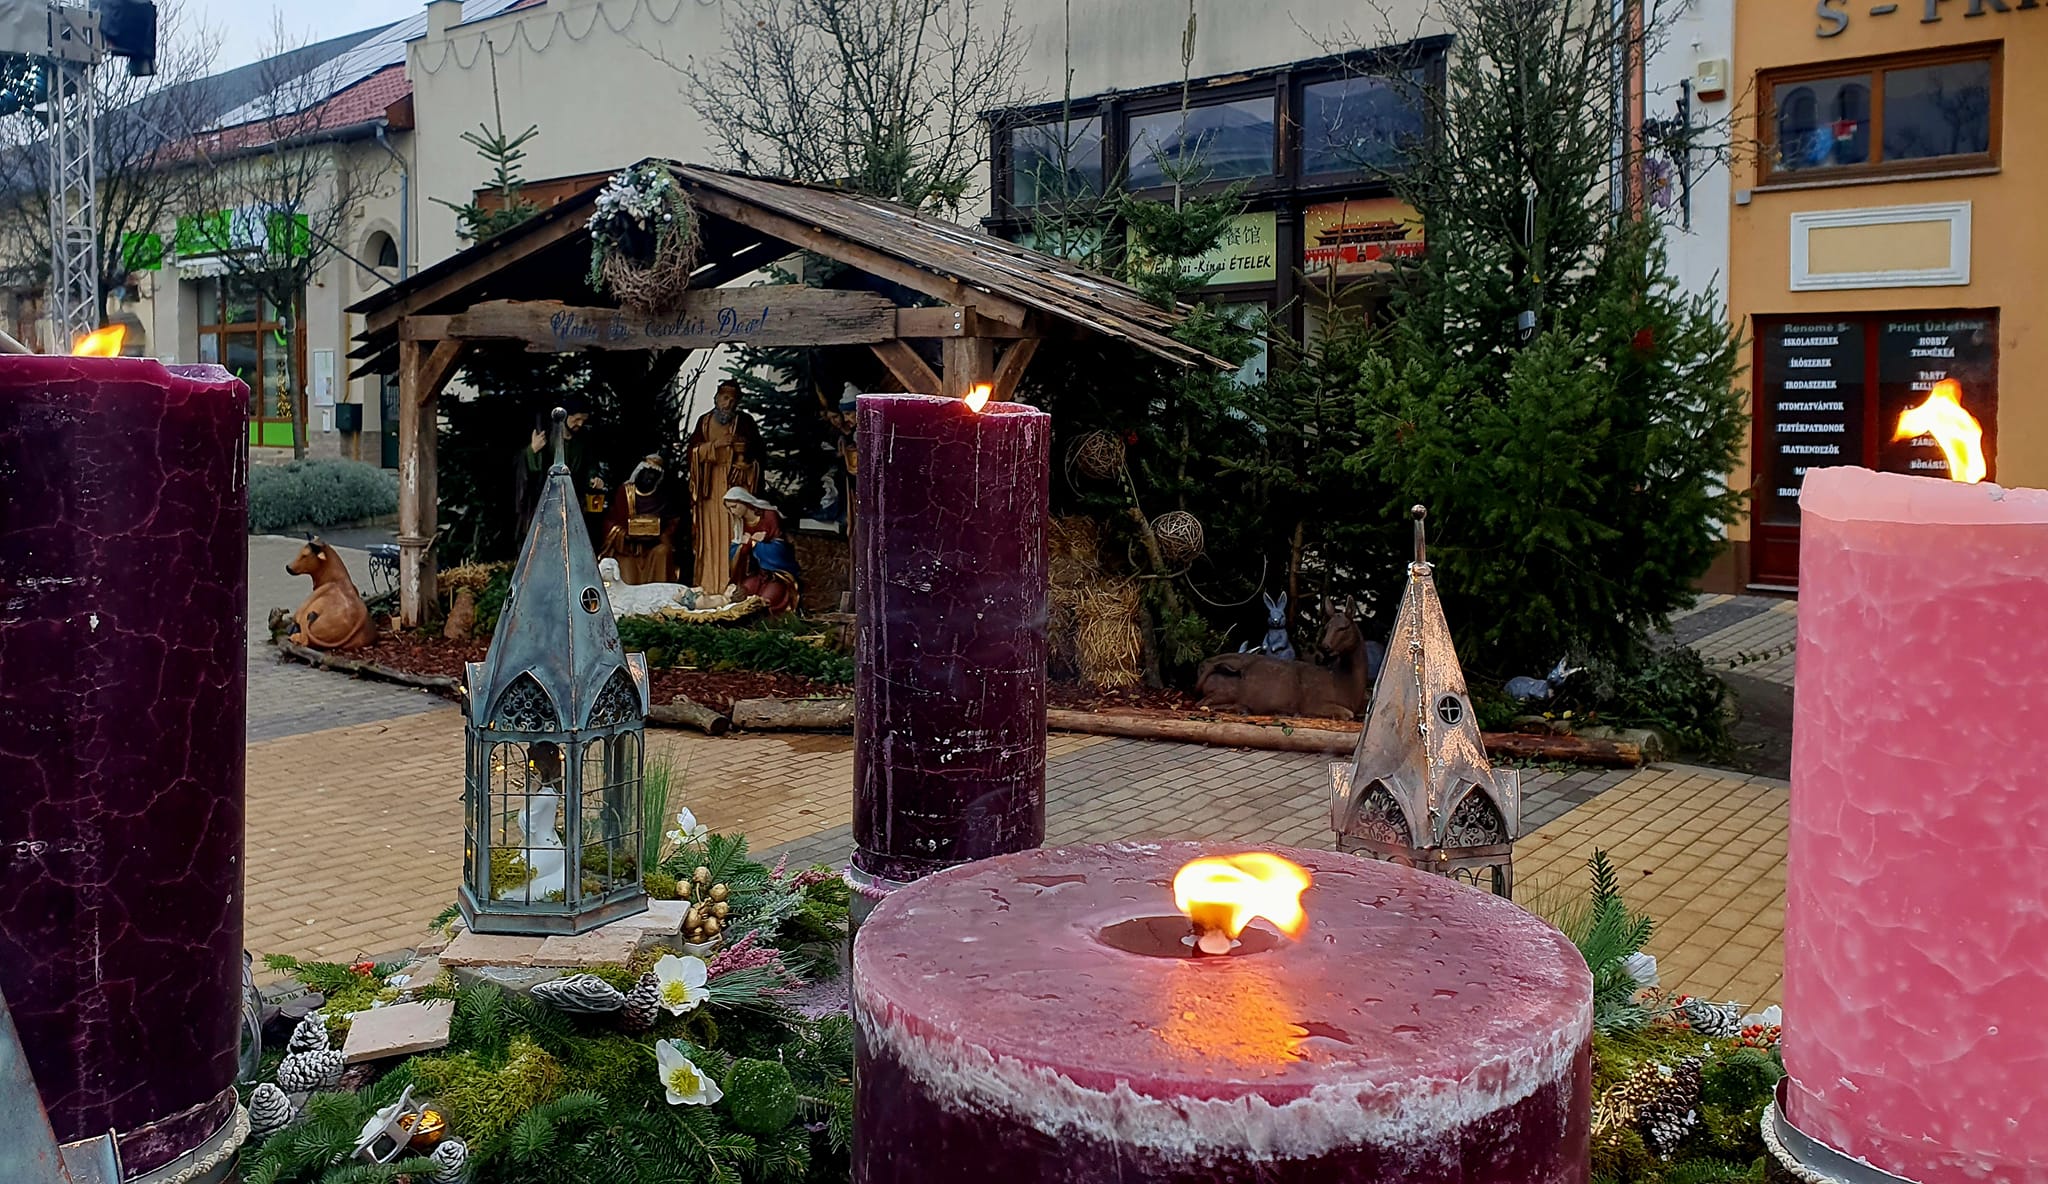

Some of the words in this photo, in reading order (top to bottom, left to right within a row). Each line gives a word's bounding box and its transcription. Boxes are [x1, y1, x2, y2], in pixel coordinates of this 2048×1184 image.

[1229, 254, 1272, 270] ÉTELEK
[710, 306, 769, 339] Deo!
[1888, 323, 1921, 333] Print
[1783, 336, 1839, 347] ISKOLASZEREK
[1919, 336, 1949, 346] HOBBY
[1790, 357, 1832, 368] ÍRÓSZEREK
[1784, 380, 1838, 390] IRODASZEREK
[1778, 401, 1844, 411] NYOMTATVÁNYOK
